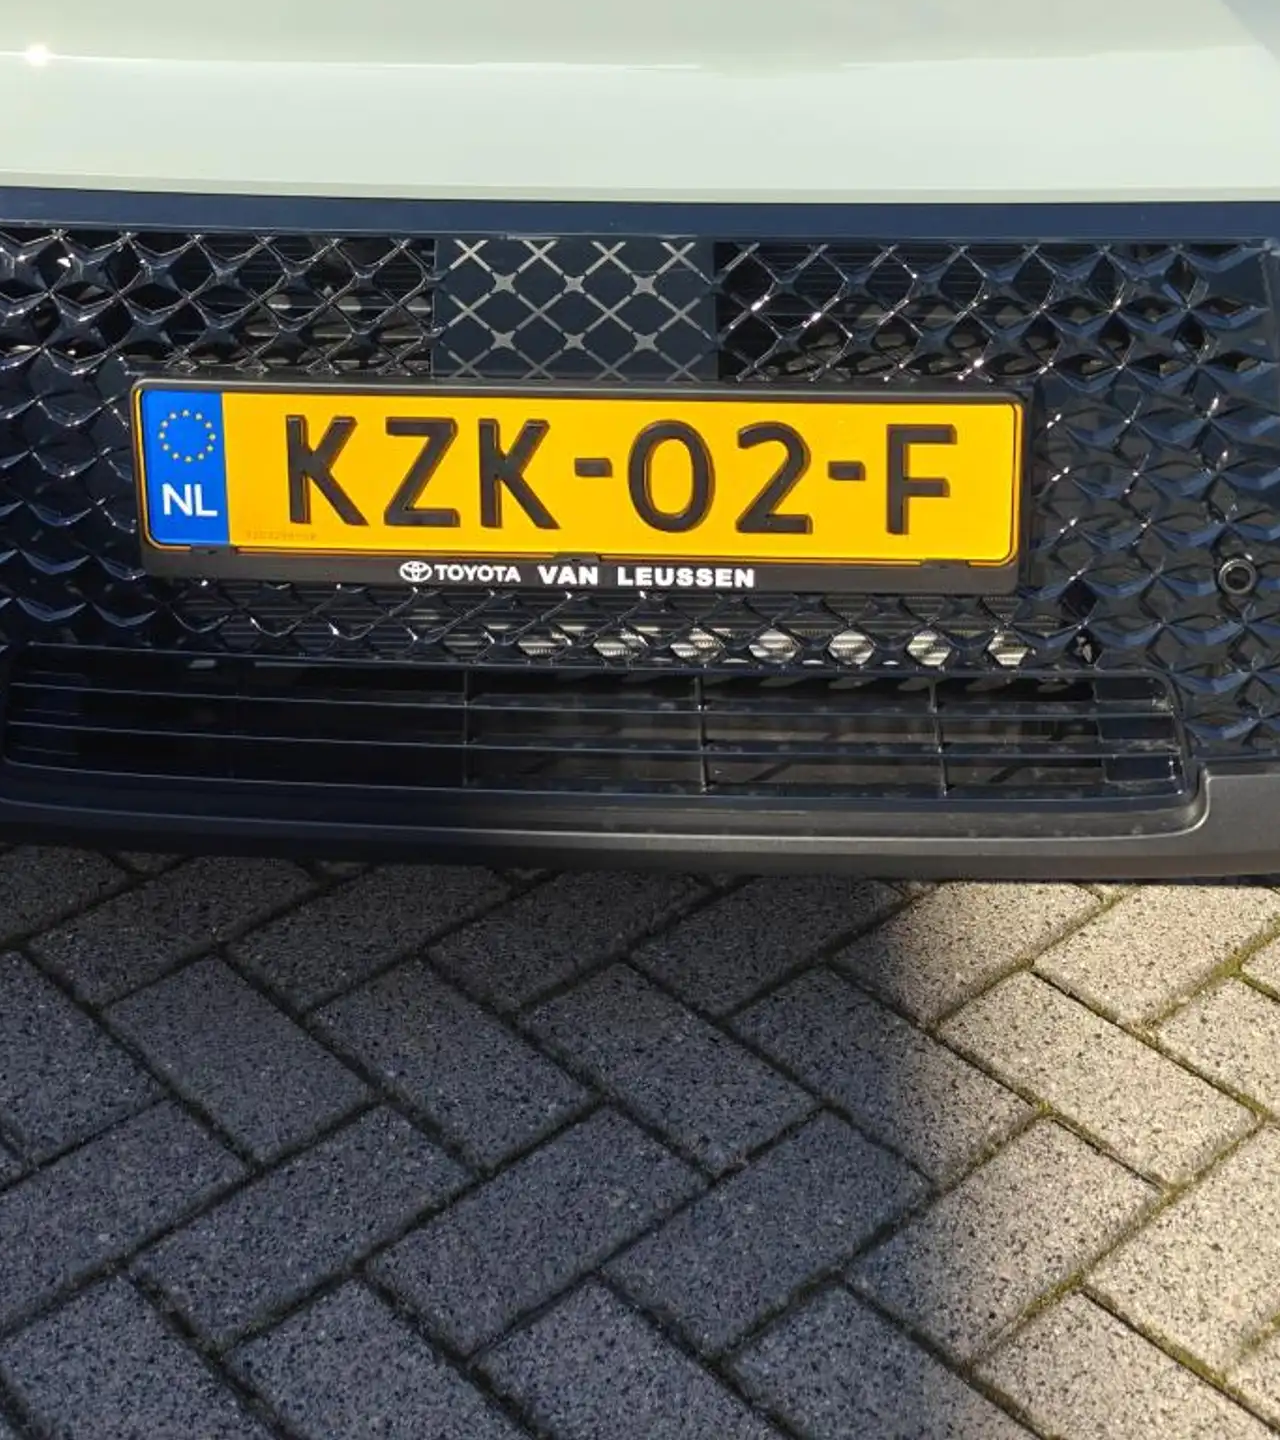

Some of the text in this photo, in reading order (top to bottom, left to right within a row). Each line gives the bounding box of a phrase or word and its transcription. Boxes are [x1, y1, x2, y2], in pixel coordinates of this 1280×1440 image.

[284, 413, 958, 536] KZK-02-F
[163, 483, 218, 517] NL
[435, 565, 756, 588] TOYOTA VAN LEUSSEN
